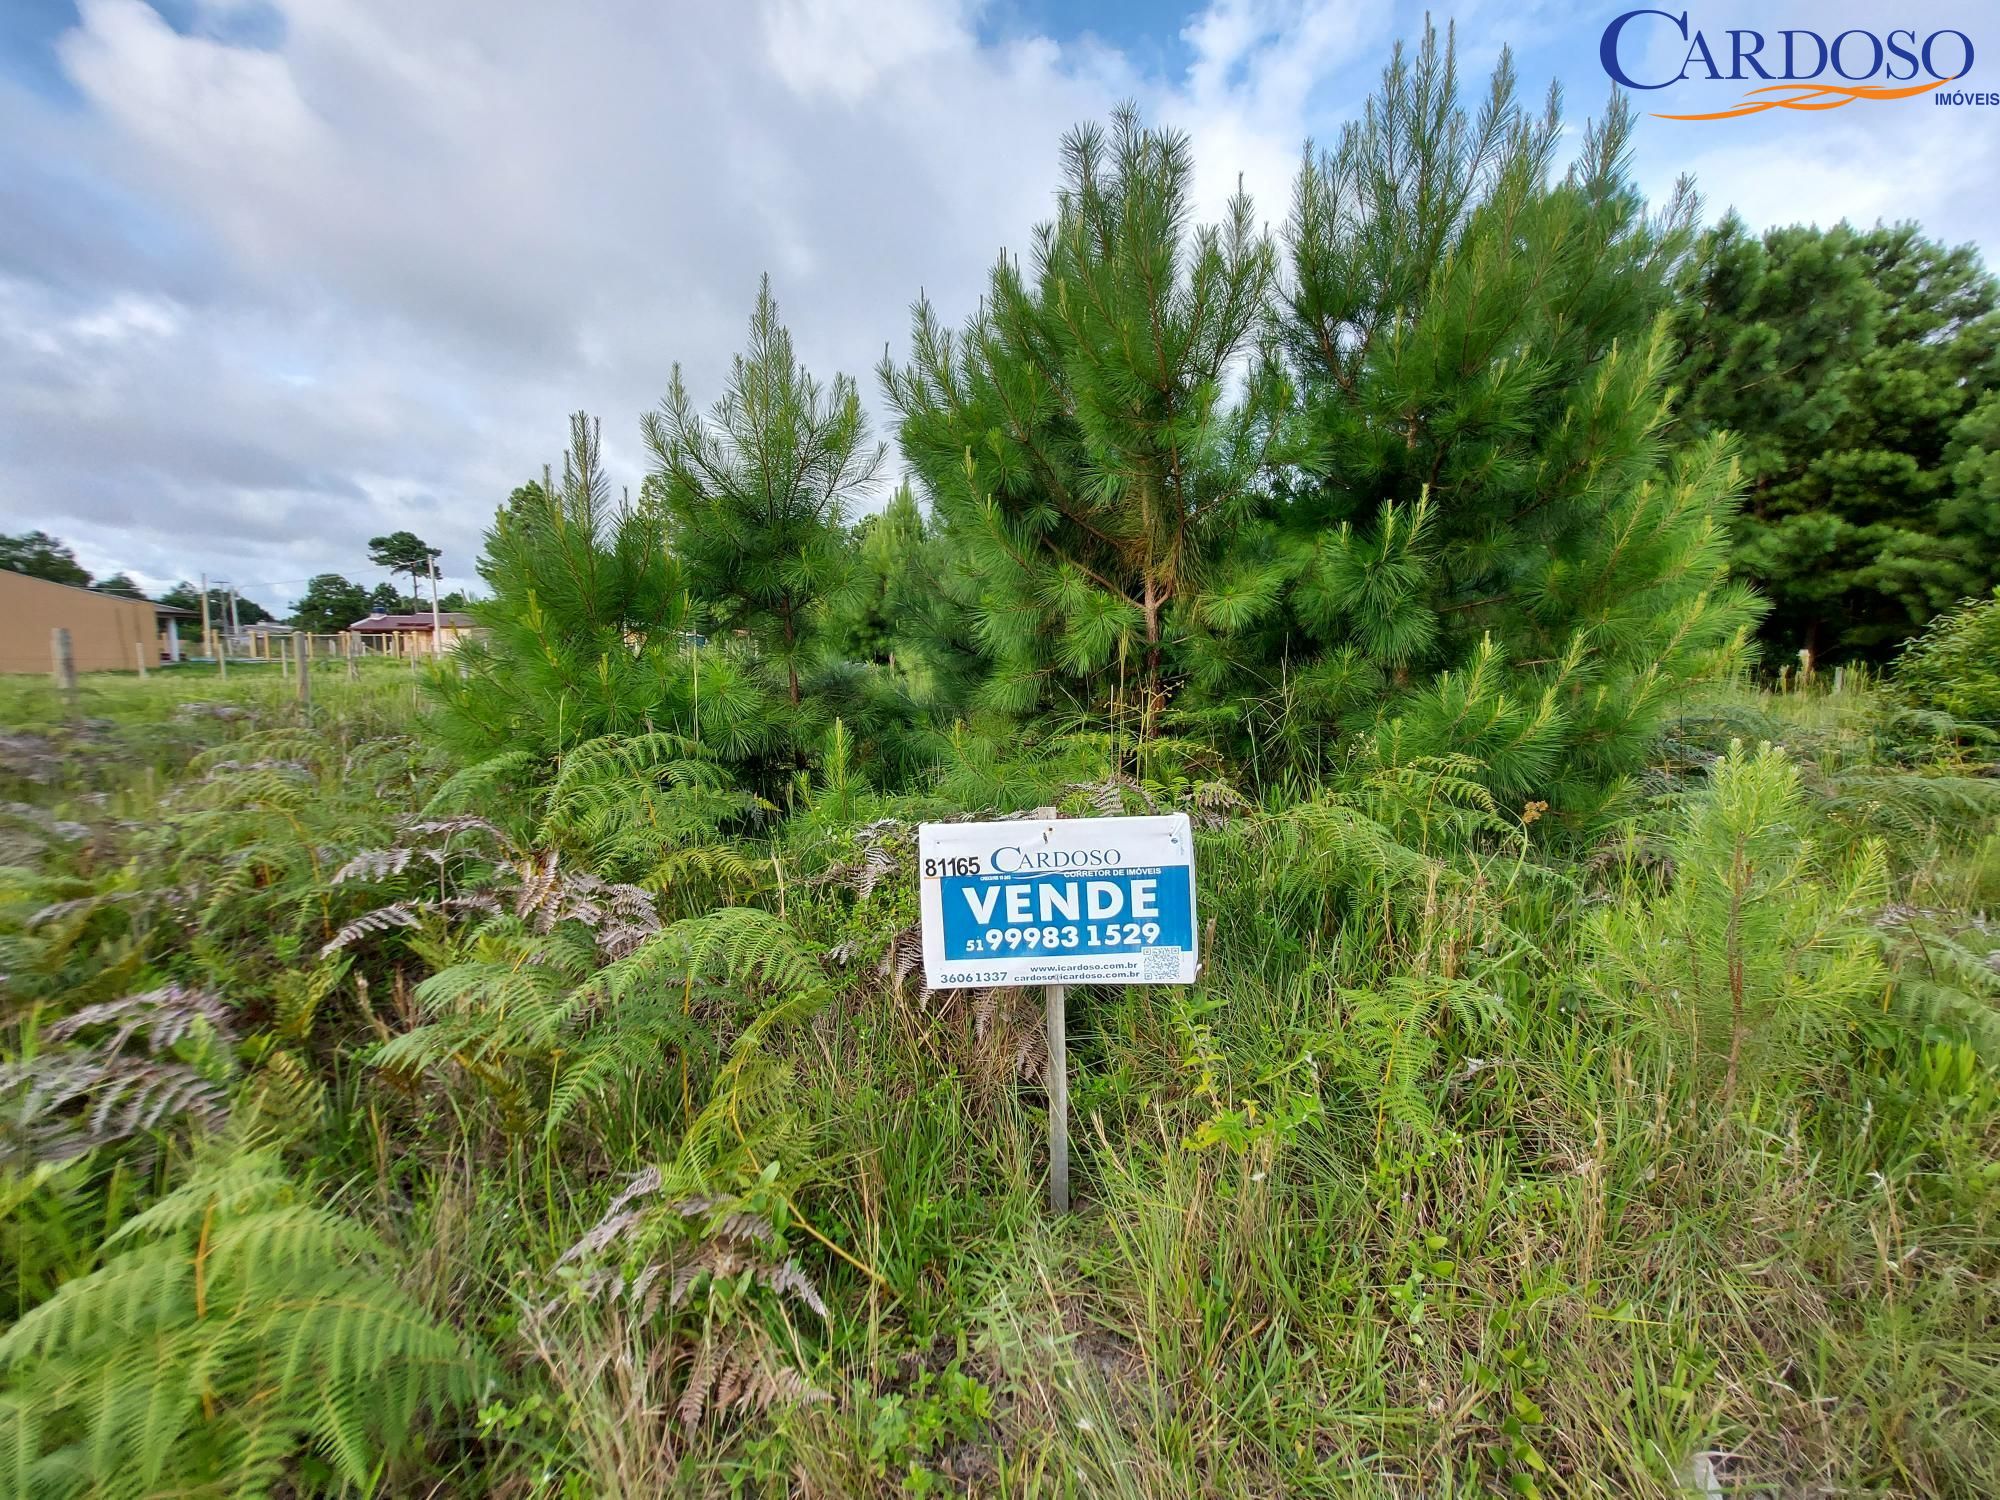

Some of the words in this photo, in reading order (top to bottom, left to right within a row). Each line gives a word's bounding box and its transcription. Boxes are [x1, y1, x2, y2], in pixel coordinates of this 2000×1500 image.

[925, 856, 981, 878] 81165
[990, 846, 1122, 873] CARDOSO
[1063, 869, 1111, 878] CORRETOR
[1112, 868, 1125, 877] DE
[1126, 866, 1162, 876] IMÓVEIS
[961, 879, 1159, 925] VENDE
[966, 939, 984, 952] 51
[985, 926, 1079, 951] 99983
[1087, 922, 1161, 947] 1529
[940, 971, 1008, 984] 36061337
[1030, 961, 1138, 973] www.icardoso.com.br
